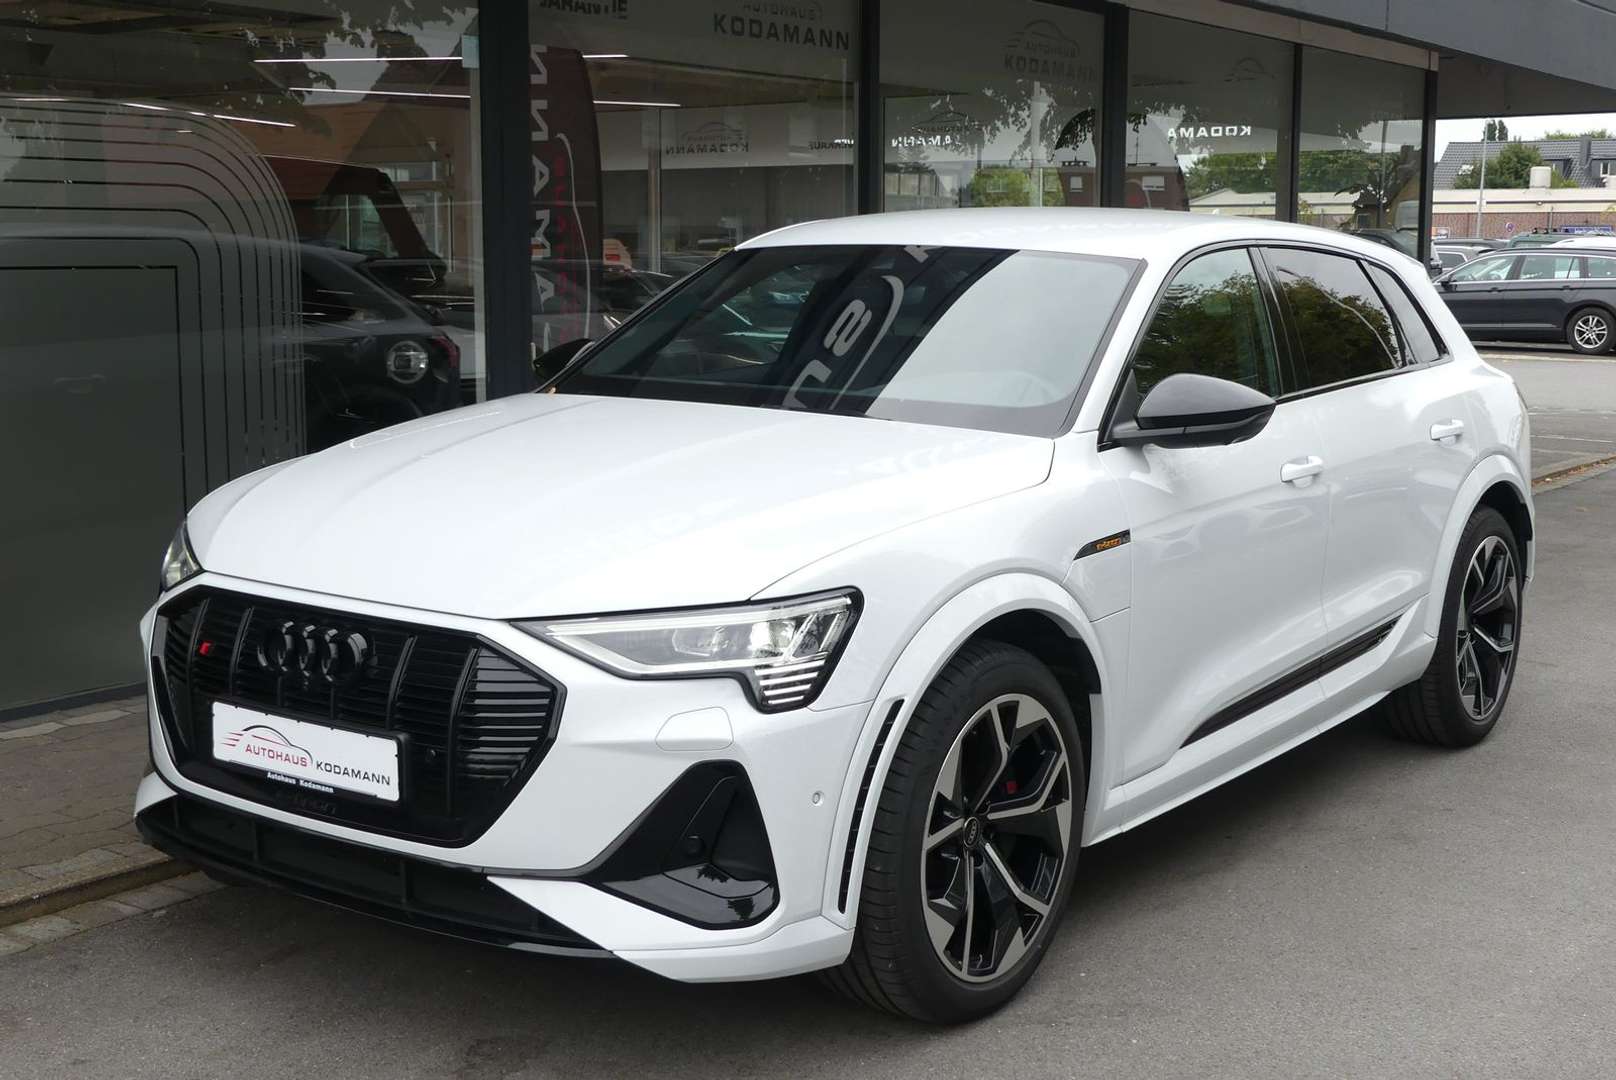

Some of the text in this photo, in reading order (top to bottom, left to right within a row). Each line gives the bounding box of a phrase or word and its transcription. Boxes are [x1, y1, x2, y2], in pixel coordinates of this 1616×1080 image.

[713, 13, 850, 51] KODAMANN
[244, 743, 391, 786] AUTOHAUS KODAMANN
[267, 771, 335, 794] Autohaus Kodamann
